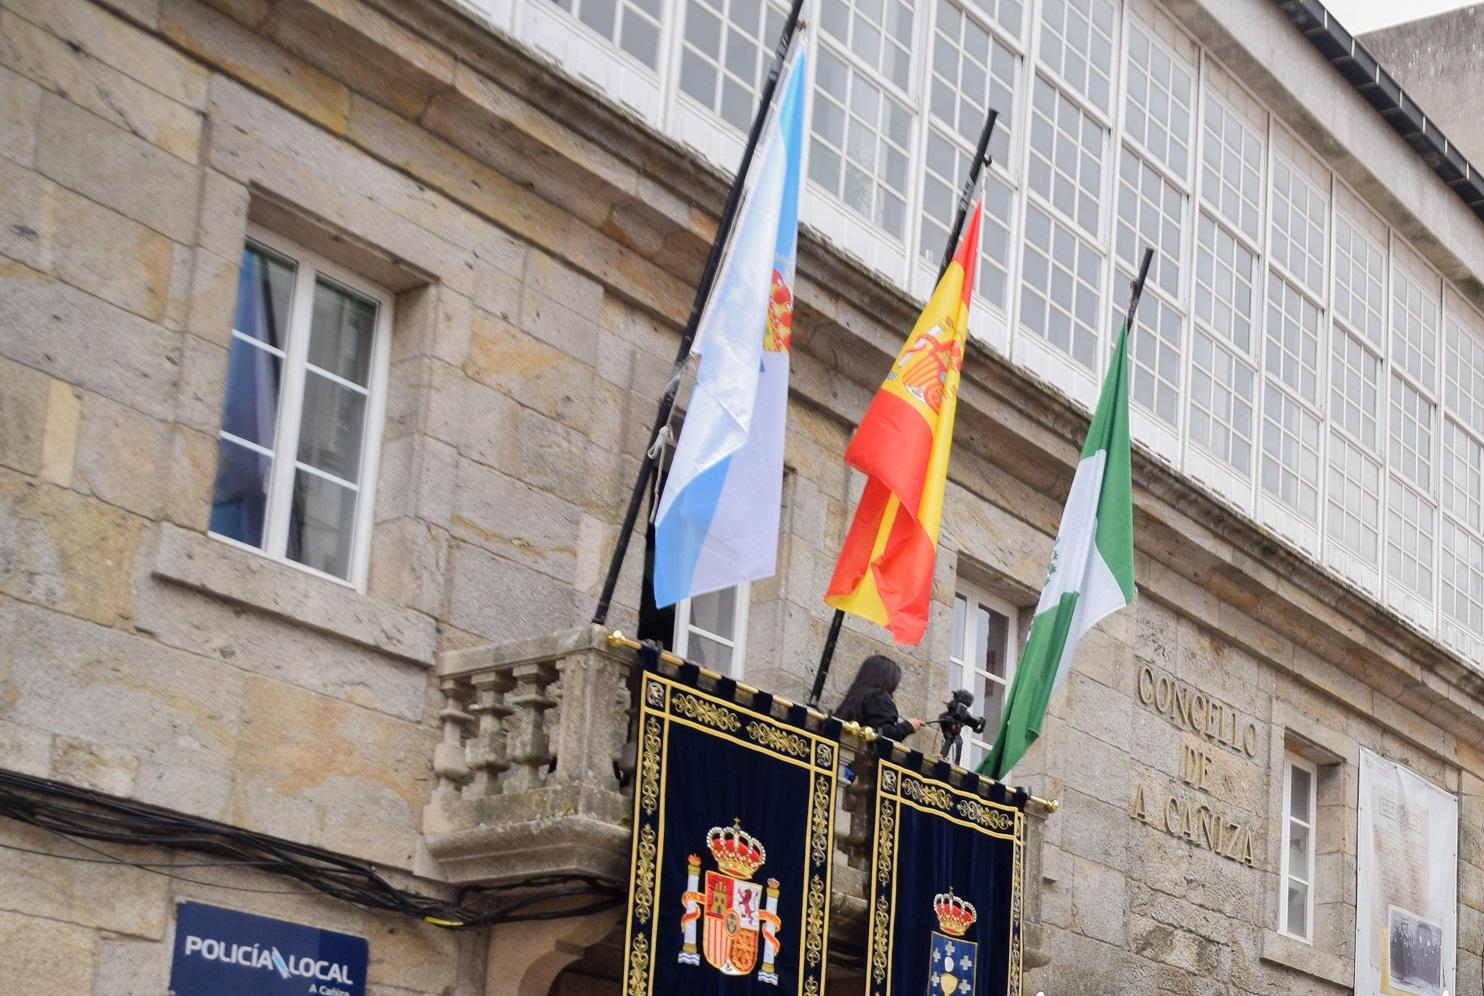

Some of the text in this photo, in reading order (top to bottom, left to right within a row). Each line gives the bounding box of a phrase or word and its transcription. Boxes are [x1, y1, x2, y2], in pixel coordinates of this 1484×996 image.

[1138, 665, 1259, 758] CONCELLO
[1183, 744, 1211, 793] DE
[1129, 783, 1254, 868] A CAÑIZA
[184, 935, 353, 985] POLICÍA LOCAL
[309, 984, 318, 993] A
